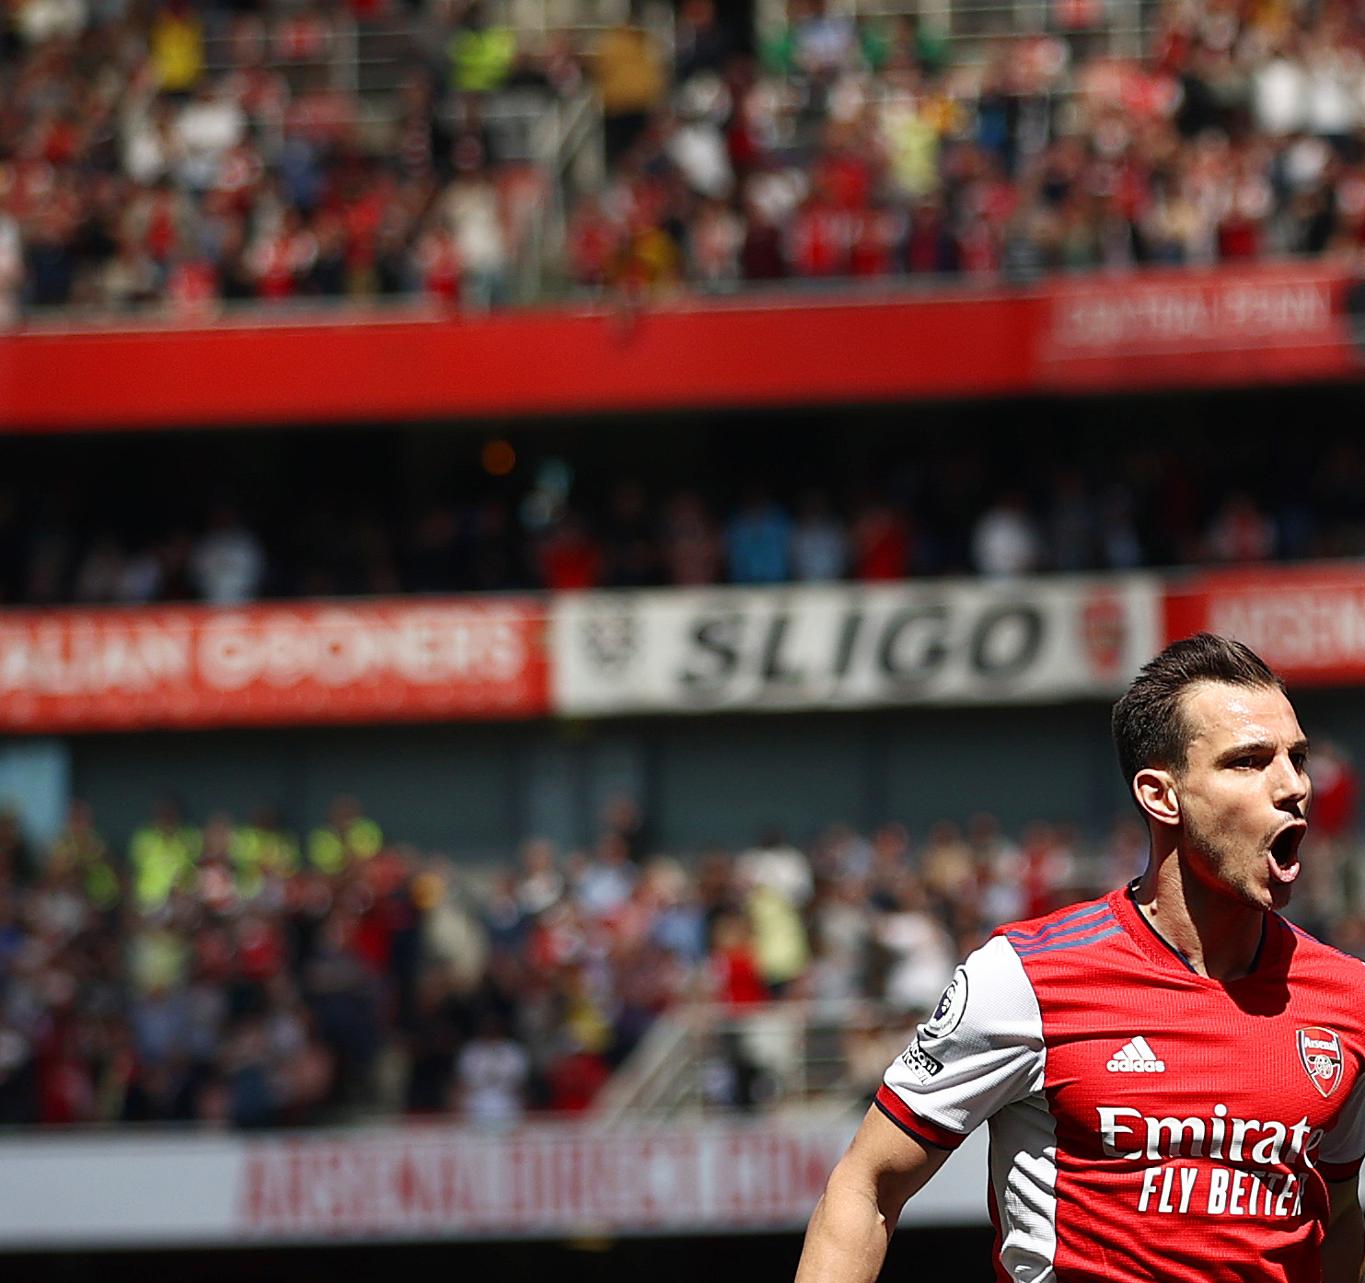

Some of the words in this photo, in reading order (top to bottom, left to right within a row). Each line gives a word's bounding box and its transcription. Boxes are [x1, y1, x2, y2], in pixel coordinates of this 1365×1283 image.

[680, 602, 1046, 690] SLIGO
[1106, 1057, 1166, 1073] adidas
[1138, 1167, 1199, 1214] FLY
